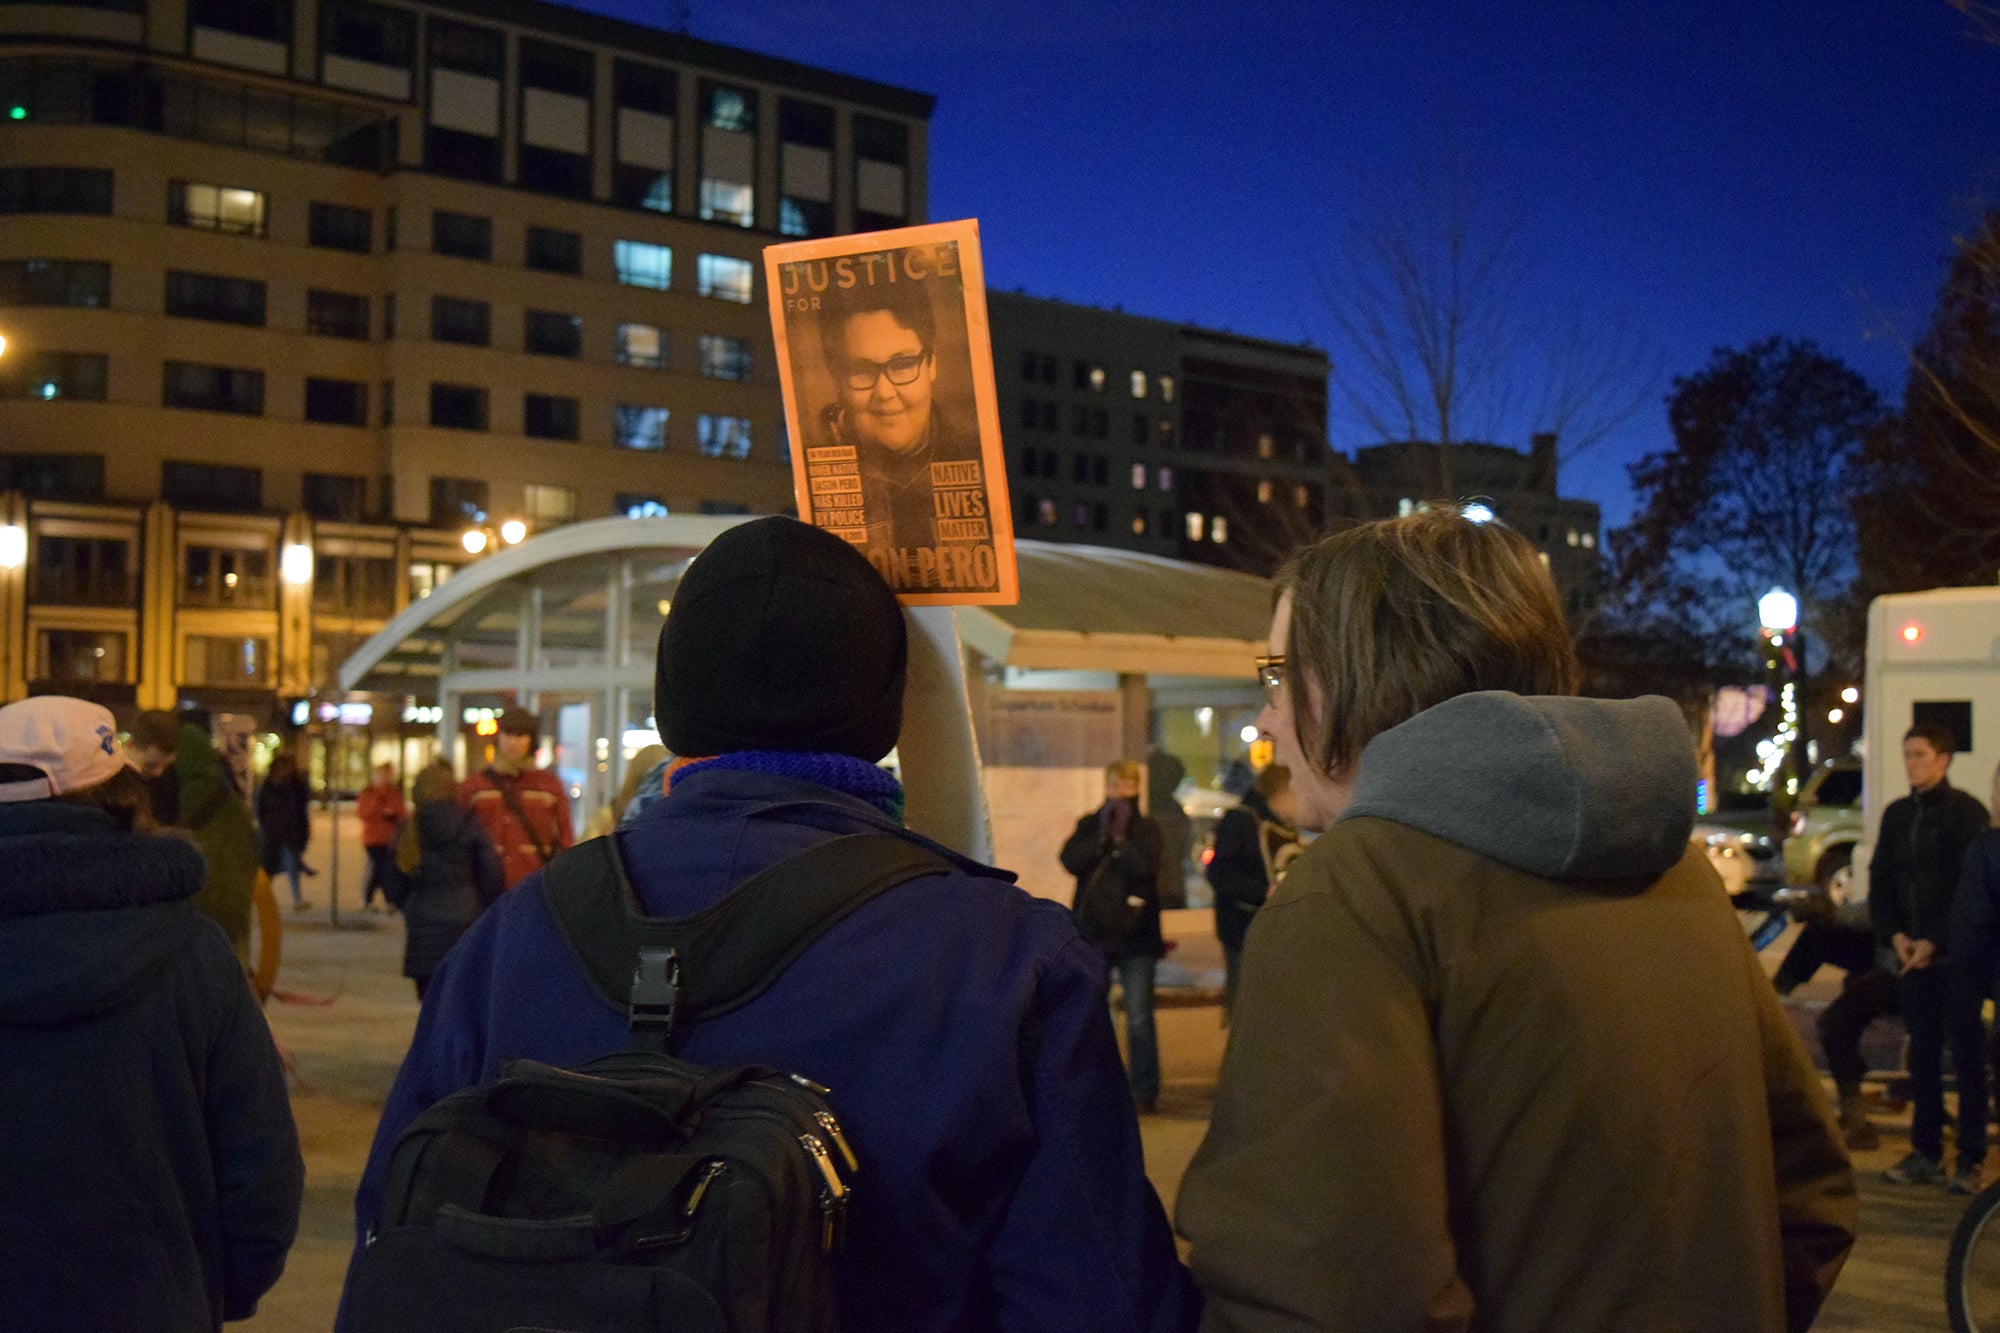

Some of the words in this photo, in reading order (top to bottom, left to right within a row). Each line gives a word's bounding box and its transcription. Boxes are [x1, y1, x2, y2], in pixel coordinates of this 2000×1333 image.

[784, 246, 954, 295] JUSTICE
[787, 296, 822, 313] FOR
[932, 463, 978, 482] NATIVE
[833, 494, 863, 507] KILLED
[935, 490, 985, 517] LIVES
[815, 511, 828, 526] BY
[830, 510, 865, 525] POLICE
[939, 520, 986, 538] MATTER
[916, 544, 995, 588] PERO
